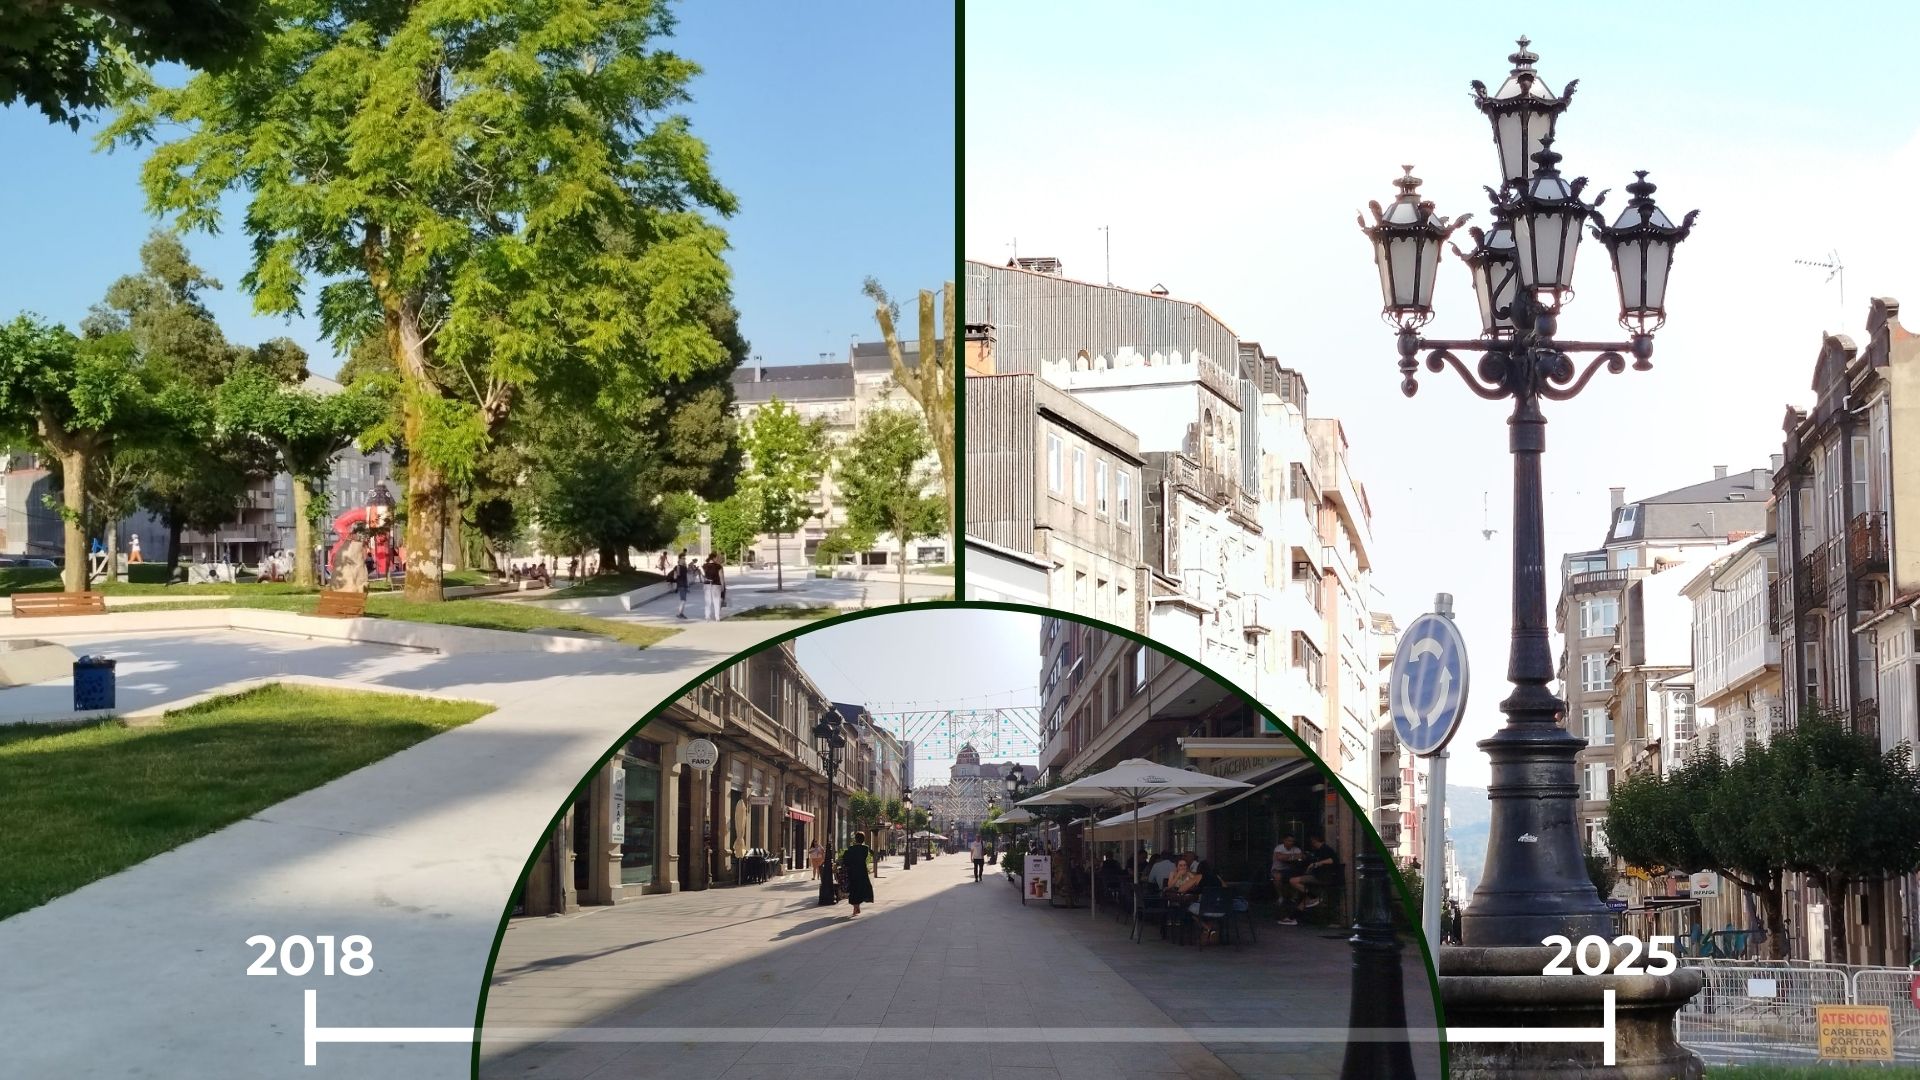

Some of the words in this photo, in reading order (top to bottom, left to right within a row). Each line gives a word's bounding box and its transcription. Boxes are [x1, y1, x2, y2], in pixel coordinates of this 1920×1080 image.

[1822, 1028, 1887, 1037] CARRETERA
[1831, 1038, 1881, 1046] CORTADA
[1825, 1046, 1847, 1055] POR
[1850, 1047, 1888, 1056] OBRAS
